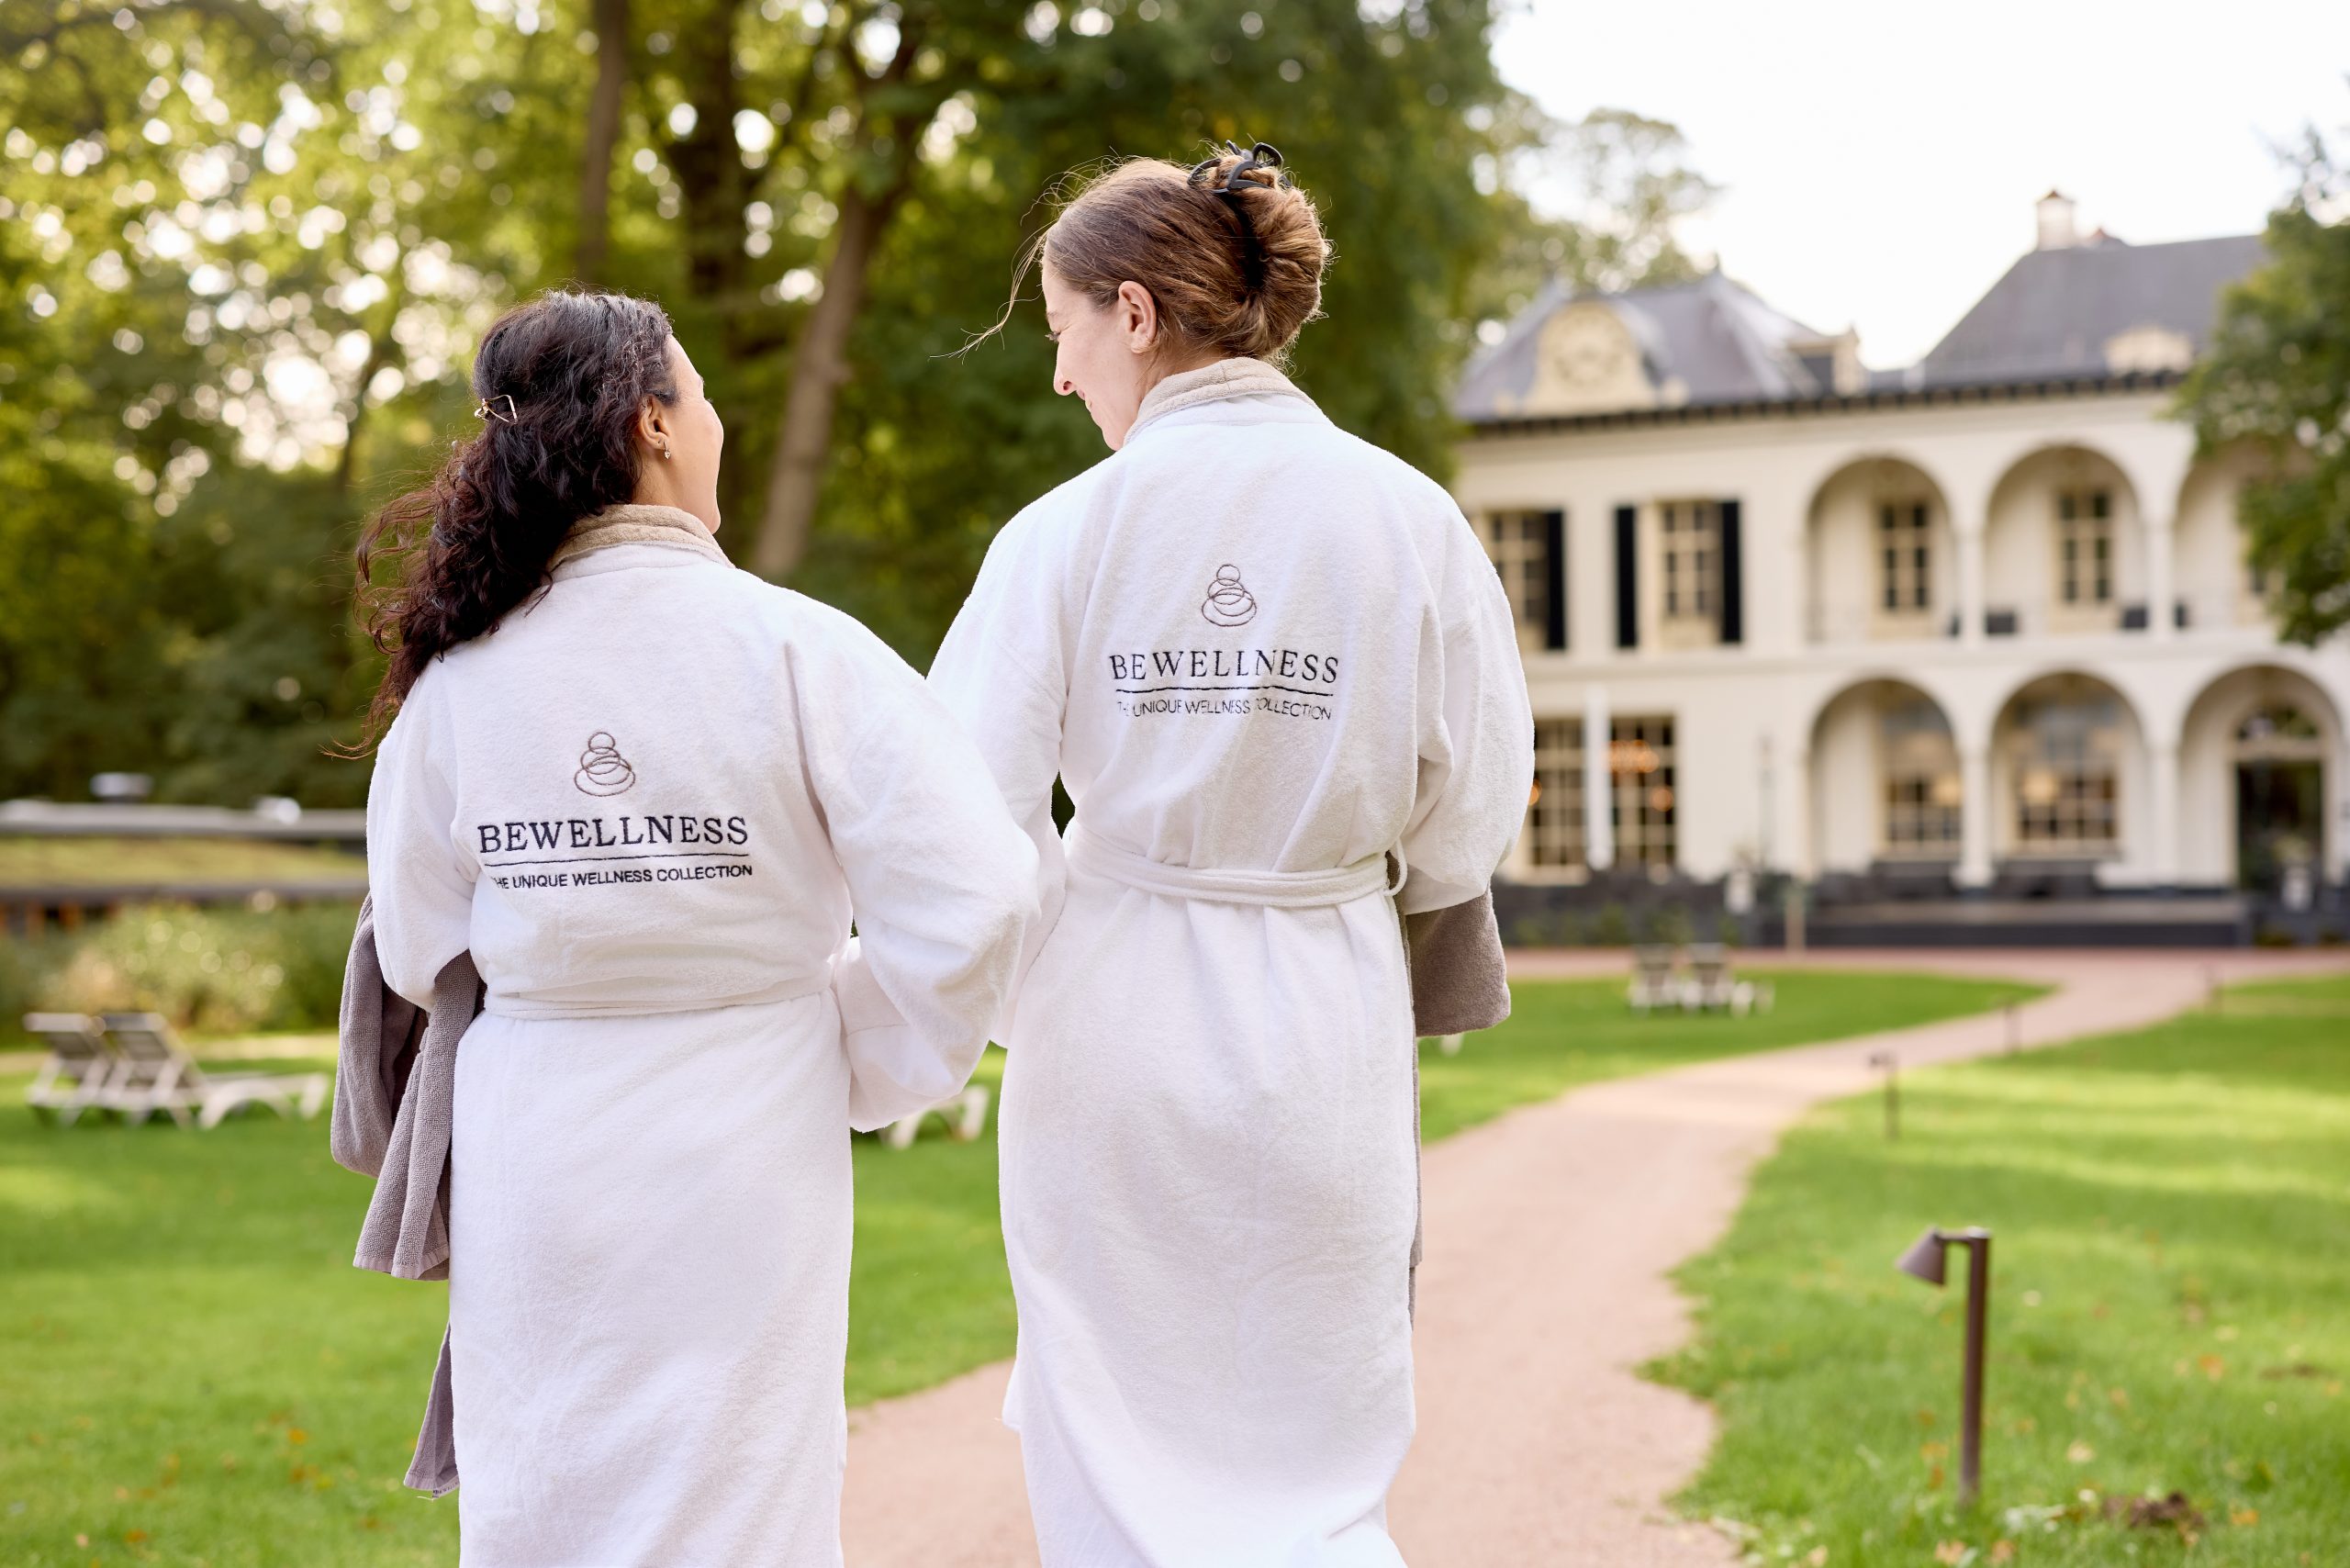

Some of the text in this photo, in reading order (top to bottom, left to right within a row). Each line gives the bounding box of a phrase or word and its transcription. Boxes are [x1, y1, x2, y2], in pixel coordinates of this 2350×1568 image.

[1109, 649, 1339, 683] BEWELLNESS
[1185, 699, 1251, 715] WELLNESS
[477, 814, 748, 854] BEWELLNESS
[511, 874, 568, 890] UNIQUE
[571, 870, 653, 888] WELLNESS
[656, 864, 753, 883] COLLECTION
